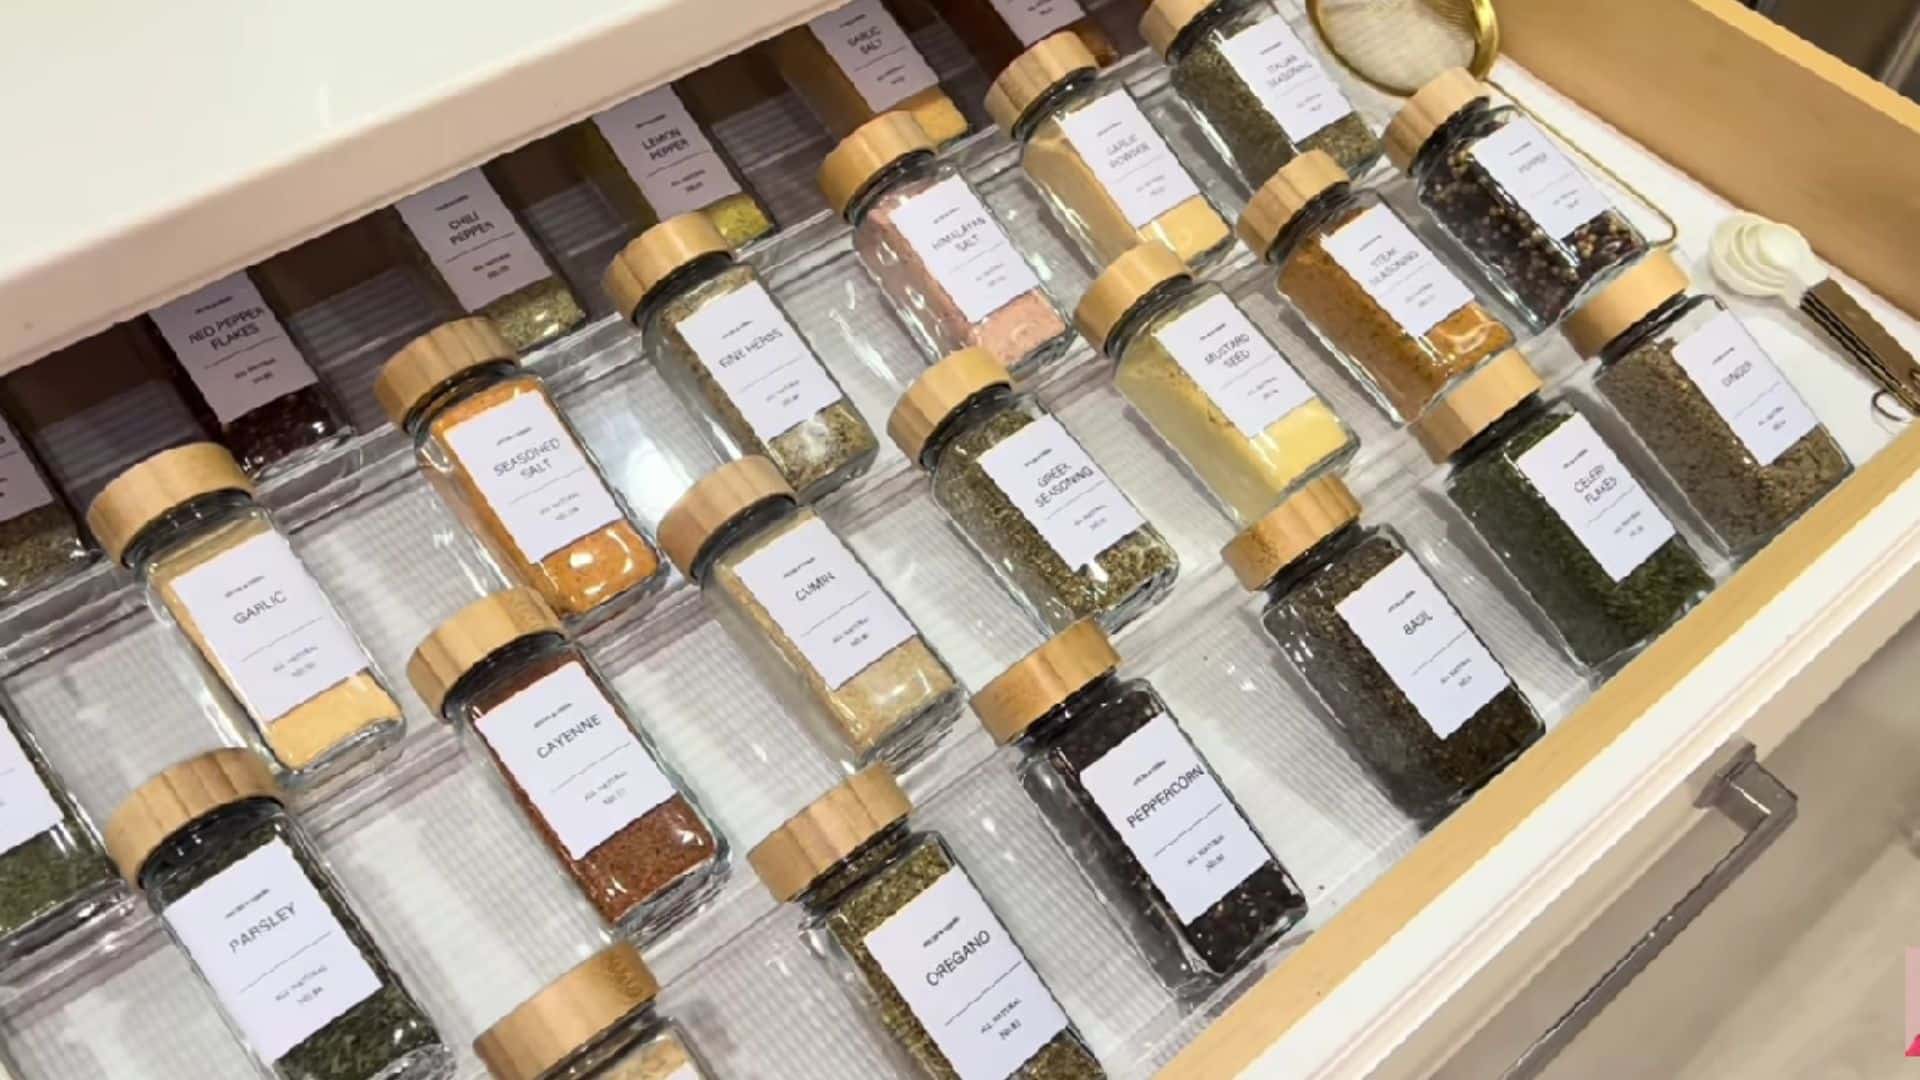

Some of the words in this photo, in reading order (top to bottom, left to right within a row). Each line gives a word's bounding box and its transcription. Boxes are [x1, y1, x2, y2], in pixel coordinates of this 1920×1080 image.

[641, 127, 683, 151] LEMON
[649, 138, 690, 160] PEPPER
[448, 210, 481, 231] CHILI
[449, 221, 496, 246] PEPPER
[188, 325, 217, 344] RED
[215, 306, 265, 331] PEPPER
[210, 322, 260, 351] FLAKES
[1204, 333, 1250, 366] MUSTARD
[1223, 350, 1251, 368] SEED
[493, 437, 561, 478] SEASONED
[520, 457, 553, 479] SALT
[1035, 465, 1094, 508] SEASONING
[1037, 463, 1073, 488] GREEK
[1574, 464, 1605, 493] CELERY
[1584, 476, 1617, 506] FLAKES
[795, 571, 836, 602] CUMIN
[233, 589, 288, 625] GARLIC
[1403, 609, 1433, 636] BASIL
[537, 713, 601, 759] CAYENNE
[1126, 763, 1205, 829] PEPPERCORN
[229, 901, 296, 954] PARSLEY
[926, 929, 991, 987] OREGANO
